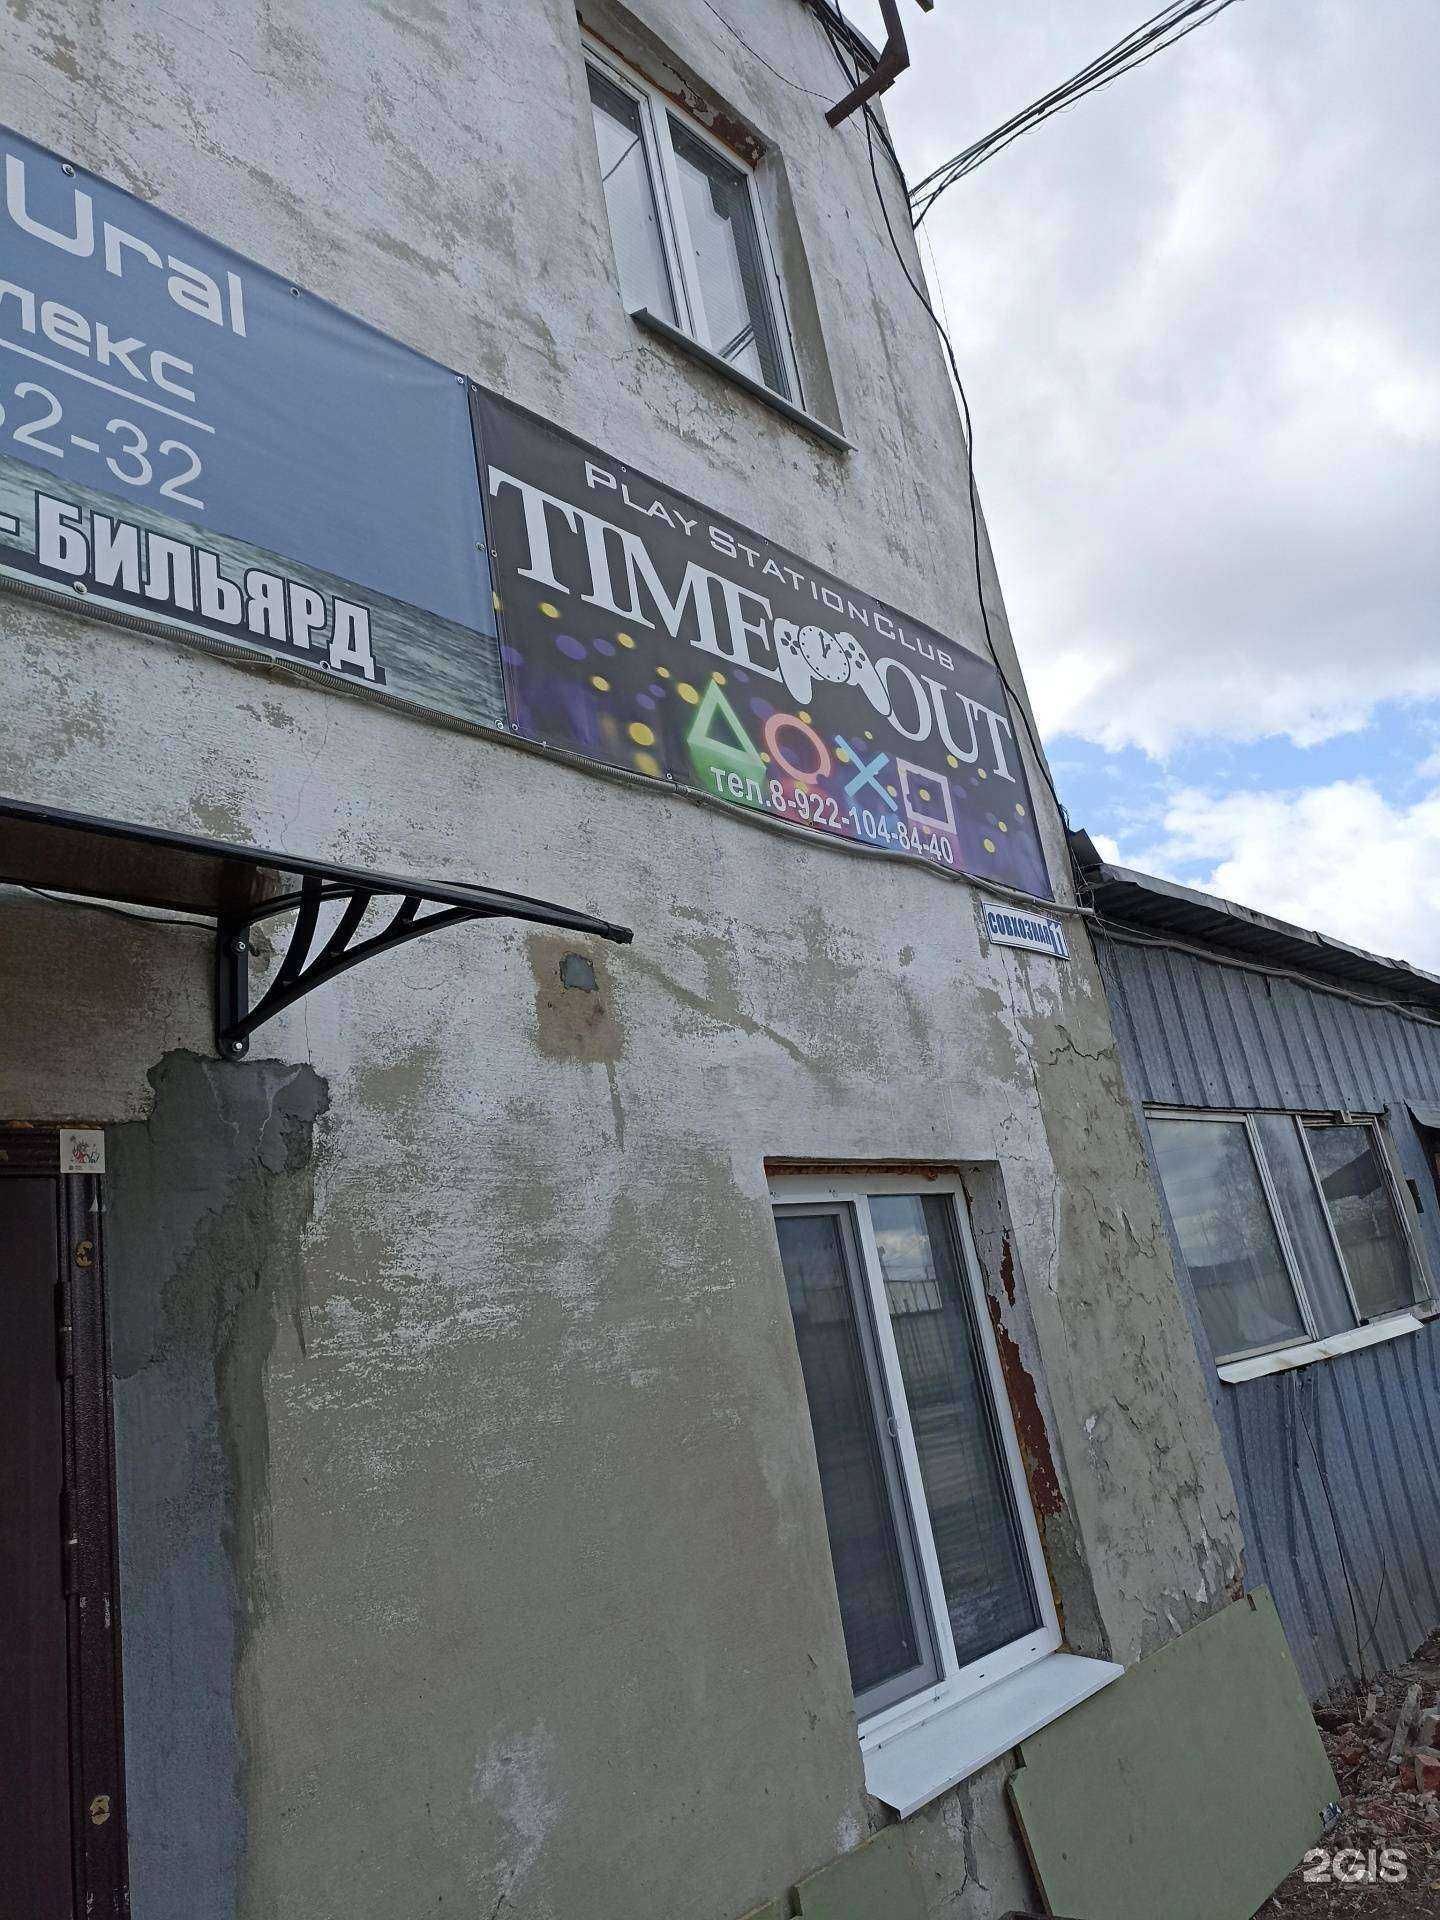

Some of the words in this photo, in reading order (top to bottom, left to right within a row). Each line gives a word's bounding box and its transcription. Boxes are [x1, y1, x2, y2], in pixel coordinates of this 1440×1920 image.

[6, 153, 247, 338] Ural
[0, 382, 205, 510] 2-32
[585, 460, 698, 536] PLAY
[35, 490, 378, 682] БИЛЬЯРД
[488, 464, 784, 683] TIME
[874, 657, 1016, 783] OUT
